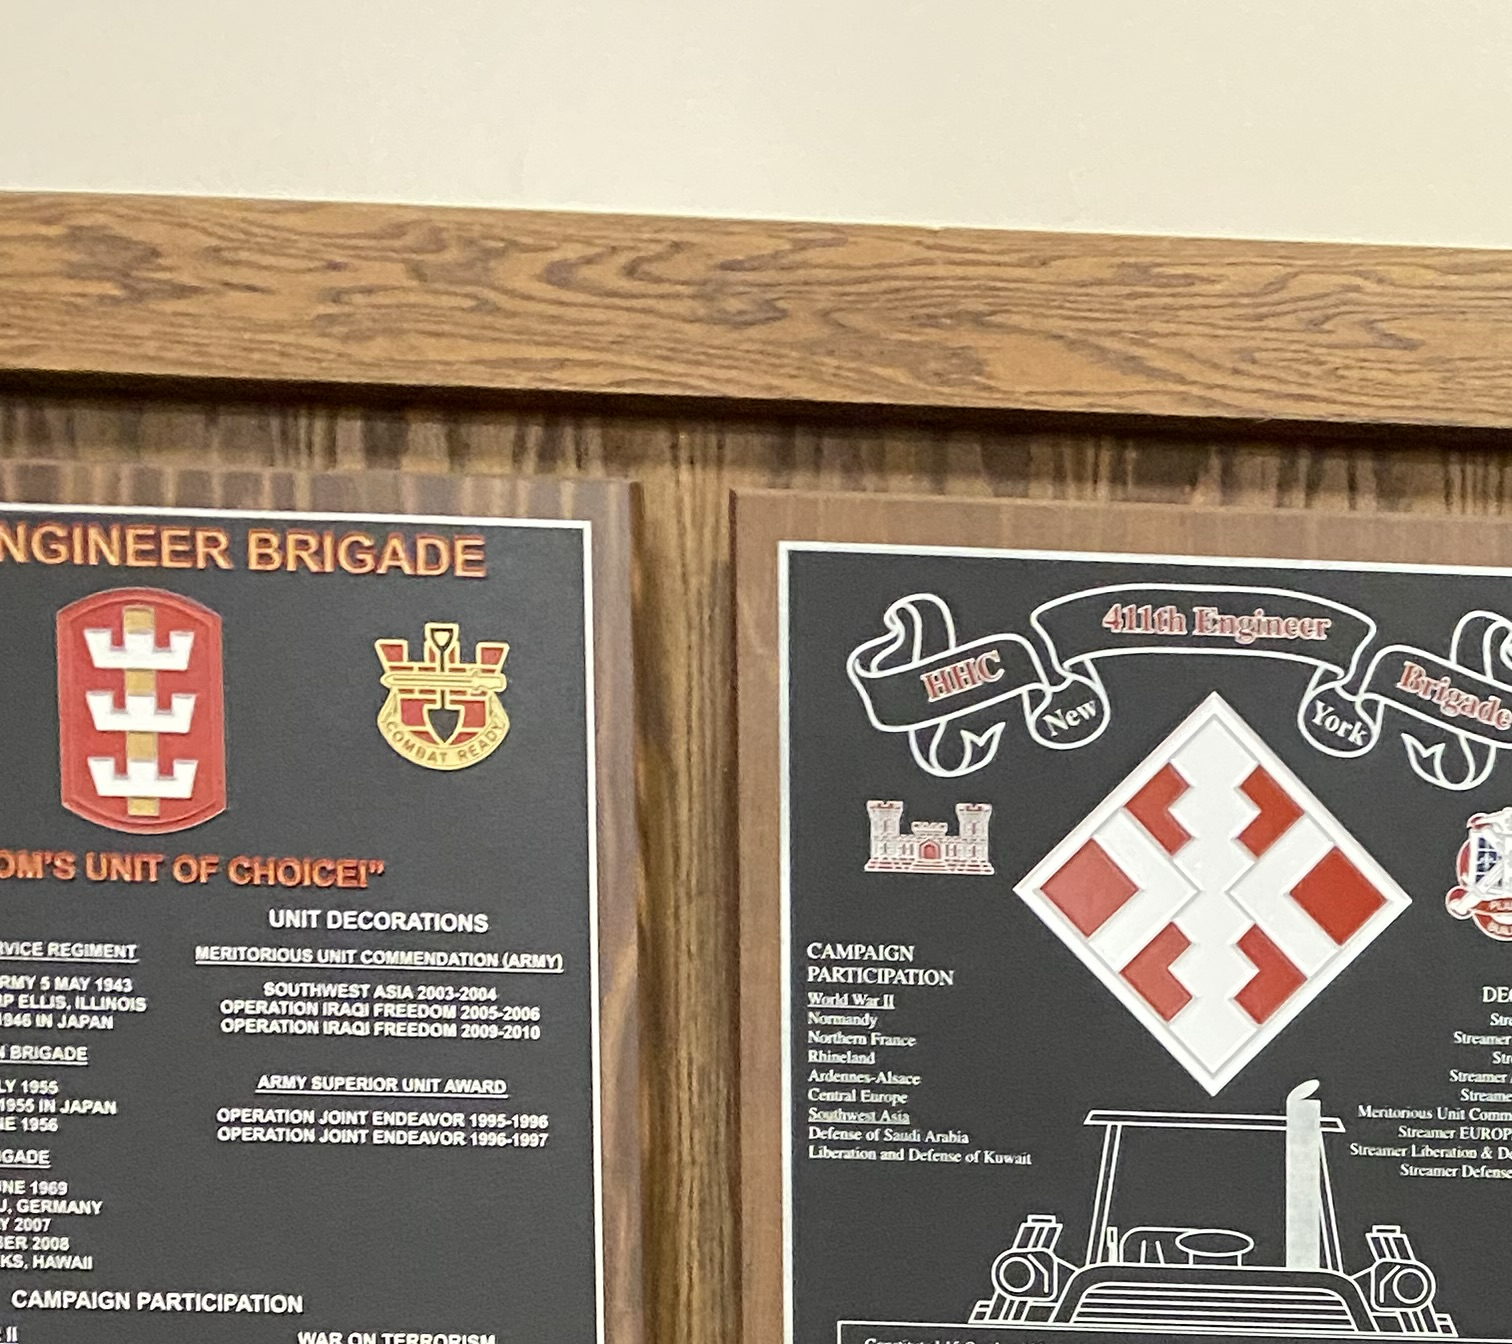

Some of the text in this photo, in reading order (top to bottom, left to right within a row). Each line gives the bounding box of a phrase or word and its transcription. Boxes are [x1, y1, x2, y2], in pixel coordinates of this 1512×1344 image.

[249, 529, 485, 577] BRIGADE
[1103, 604, 1333, 645] 411th Engineer
[920, 650, 1005, 703] HHC
[1396, 661, 1512, 730] Brigade
[1042, 699, 1098, 738] New
[1311, 700, 1369, 747] York
[386, 720, 506, 763] COMBAT READY
[86, 853, 163, 882] UNIT
[173, 854, 218, 883] OF
[269, 909, 488, 933] UNIT DECORATIONS
[196, 946, 562, 969] MERITORIOUS UNIT COMMENDATION (ARMY)
[807, 942, 914, 962] CAMPAIGN
[807, 966, 954, 986] PARTICIPATION
[264, 982, 497, 1001] SOUTHWEST ASIA 2003-2004
[220, 1000, 540, 1021] OPERATION IRAQI FREEDOM 2005-2006
[258, 1075, 506, 1093] ARMY SUPERIOR UNIT AWARD
[808, 1088, 907, 1107] Central Europe
[217, 1108, 548, 1129] OPERATION JOINT ENDEAVOR 1995-1996
[809, 1126, 969, 1143] Defense of Saudi Arabia
[1398, 1126, 1456, 1138] Streamer
[809, 1145, 1031, 1164] Liberation and Defense of Kuwait
[12, 1290, 302, 1313] CAMPAIGN PARTICIPATION
